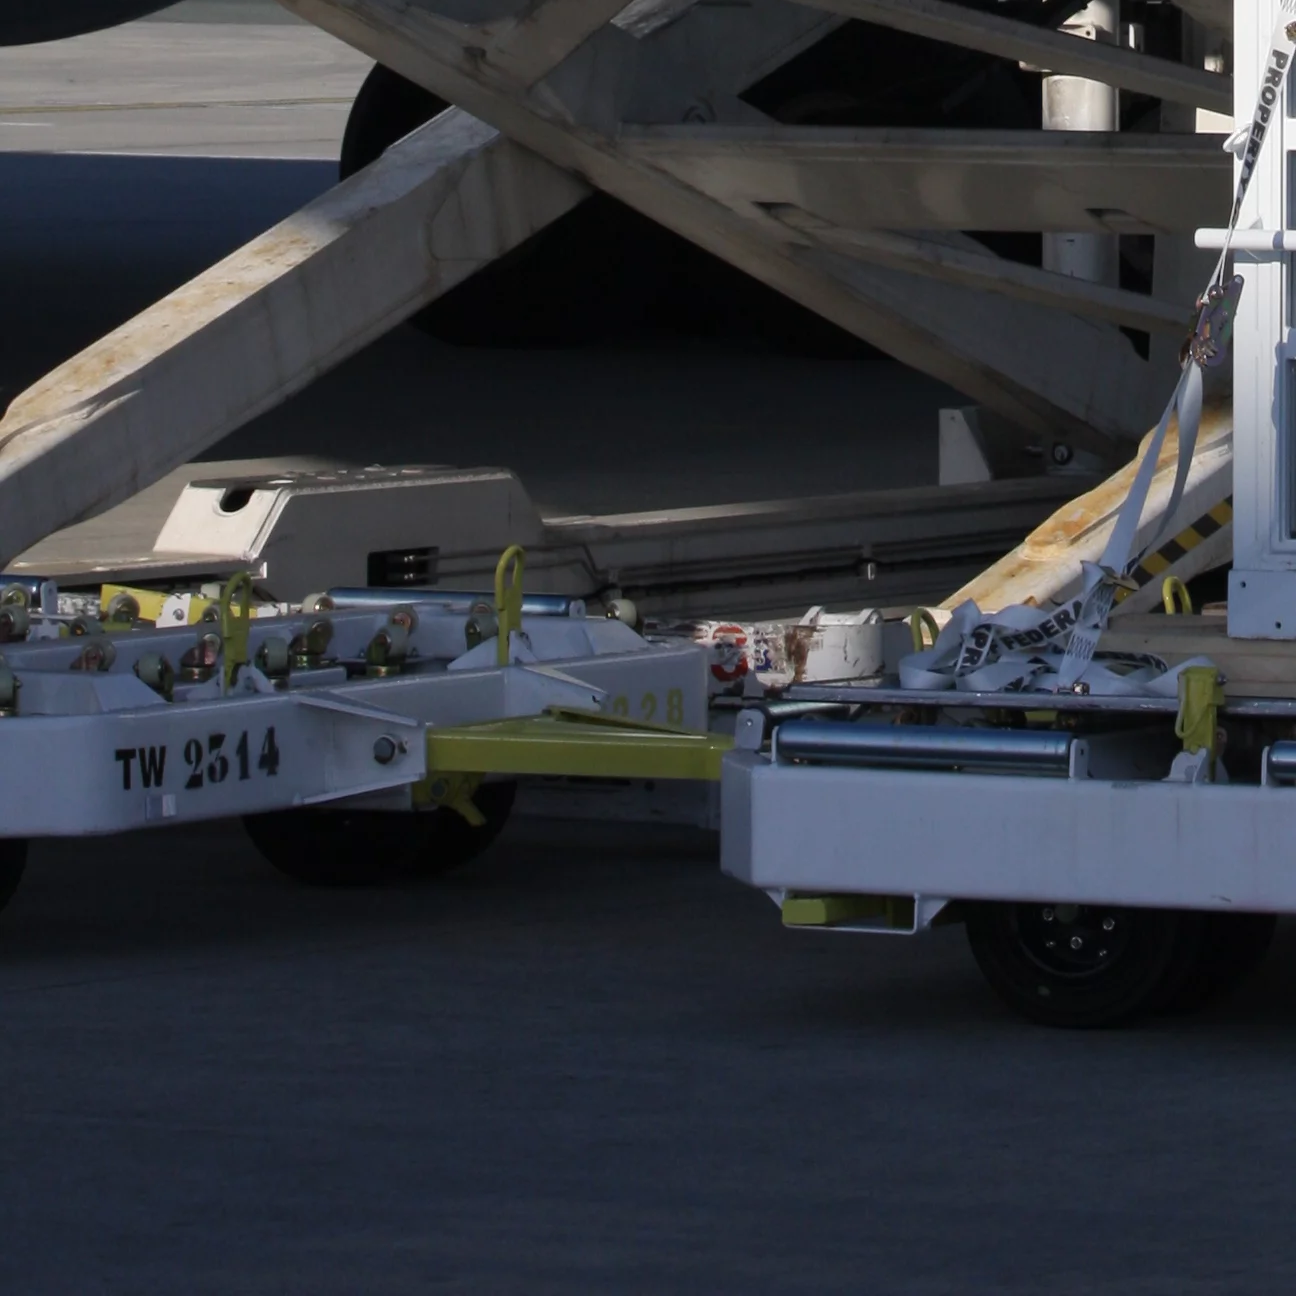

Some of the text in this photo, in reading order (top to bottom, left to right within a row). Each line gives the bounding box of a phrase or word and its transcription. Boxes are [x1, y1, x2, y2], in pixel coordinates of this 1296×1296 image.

[1239, 48, 1290, 196] PROPERTY
[115, 724, 280, 790] TW 2314
